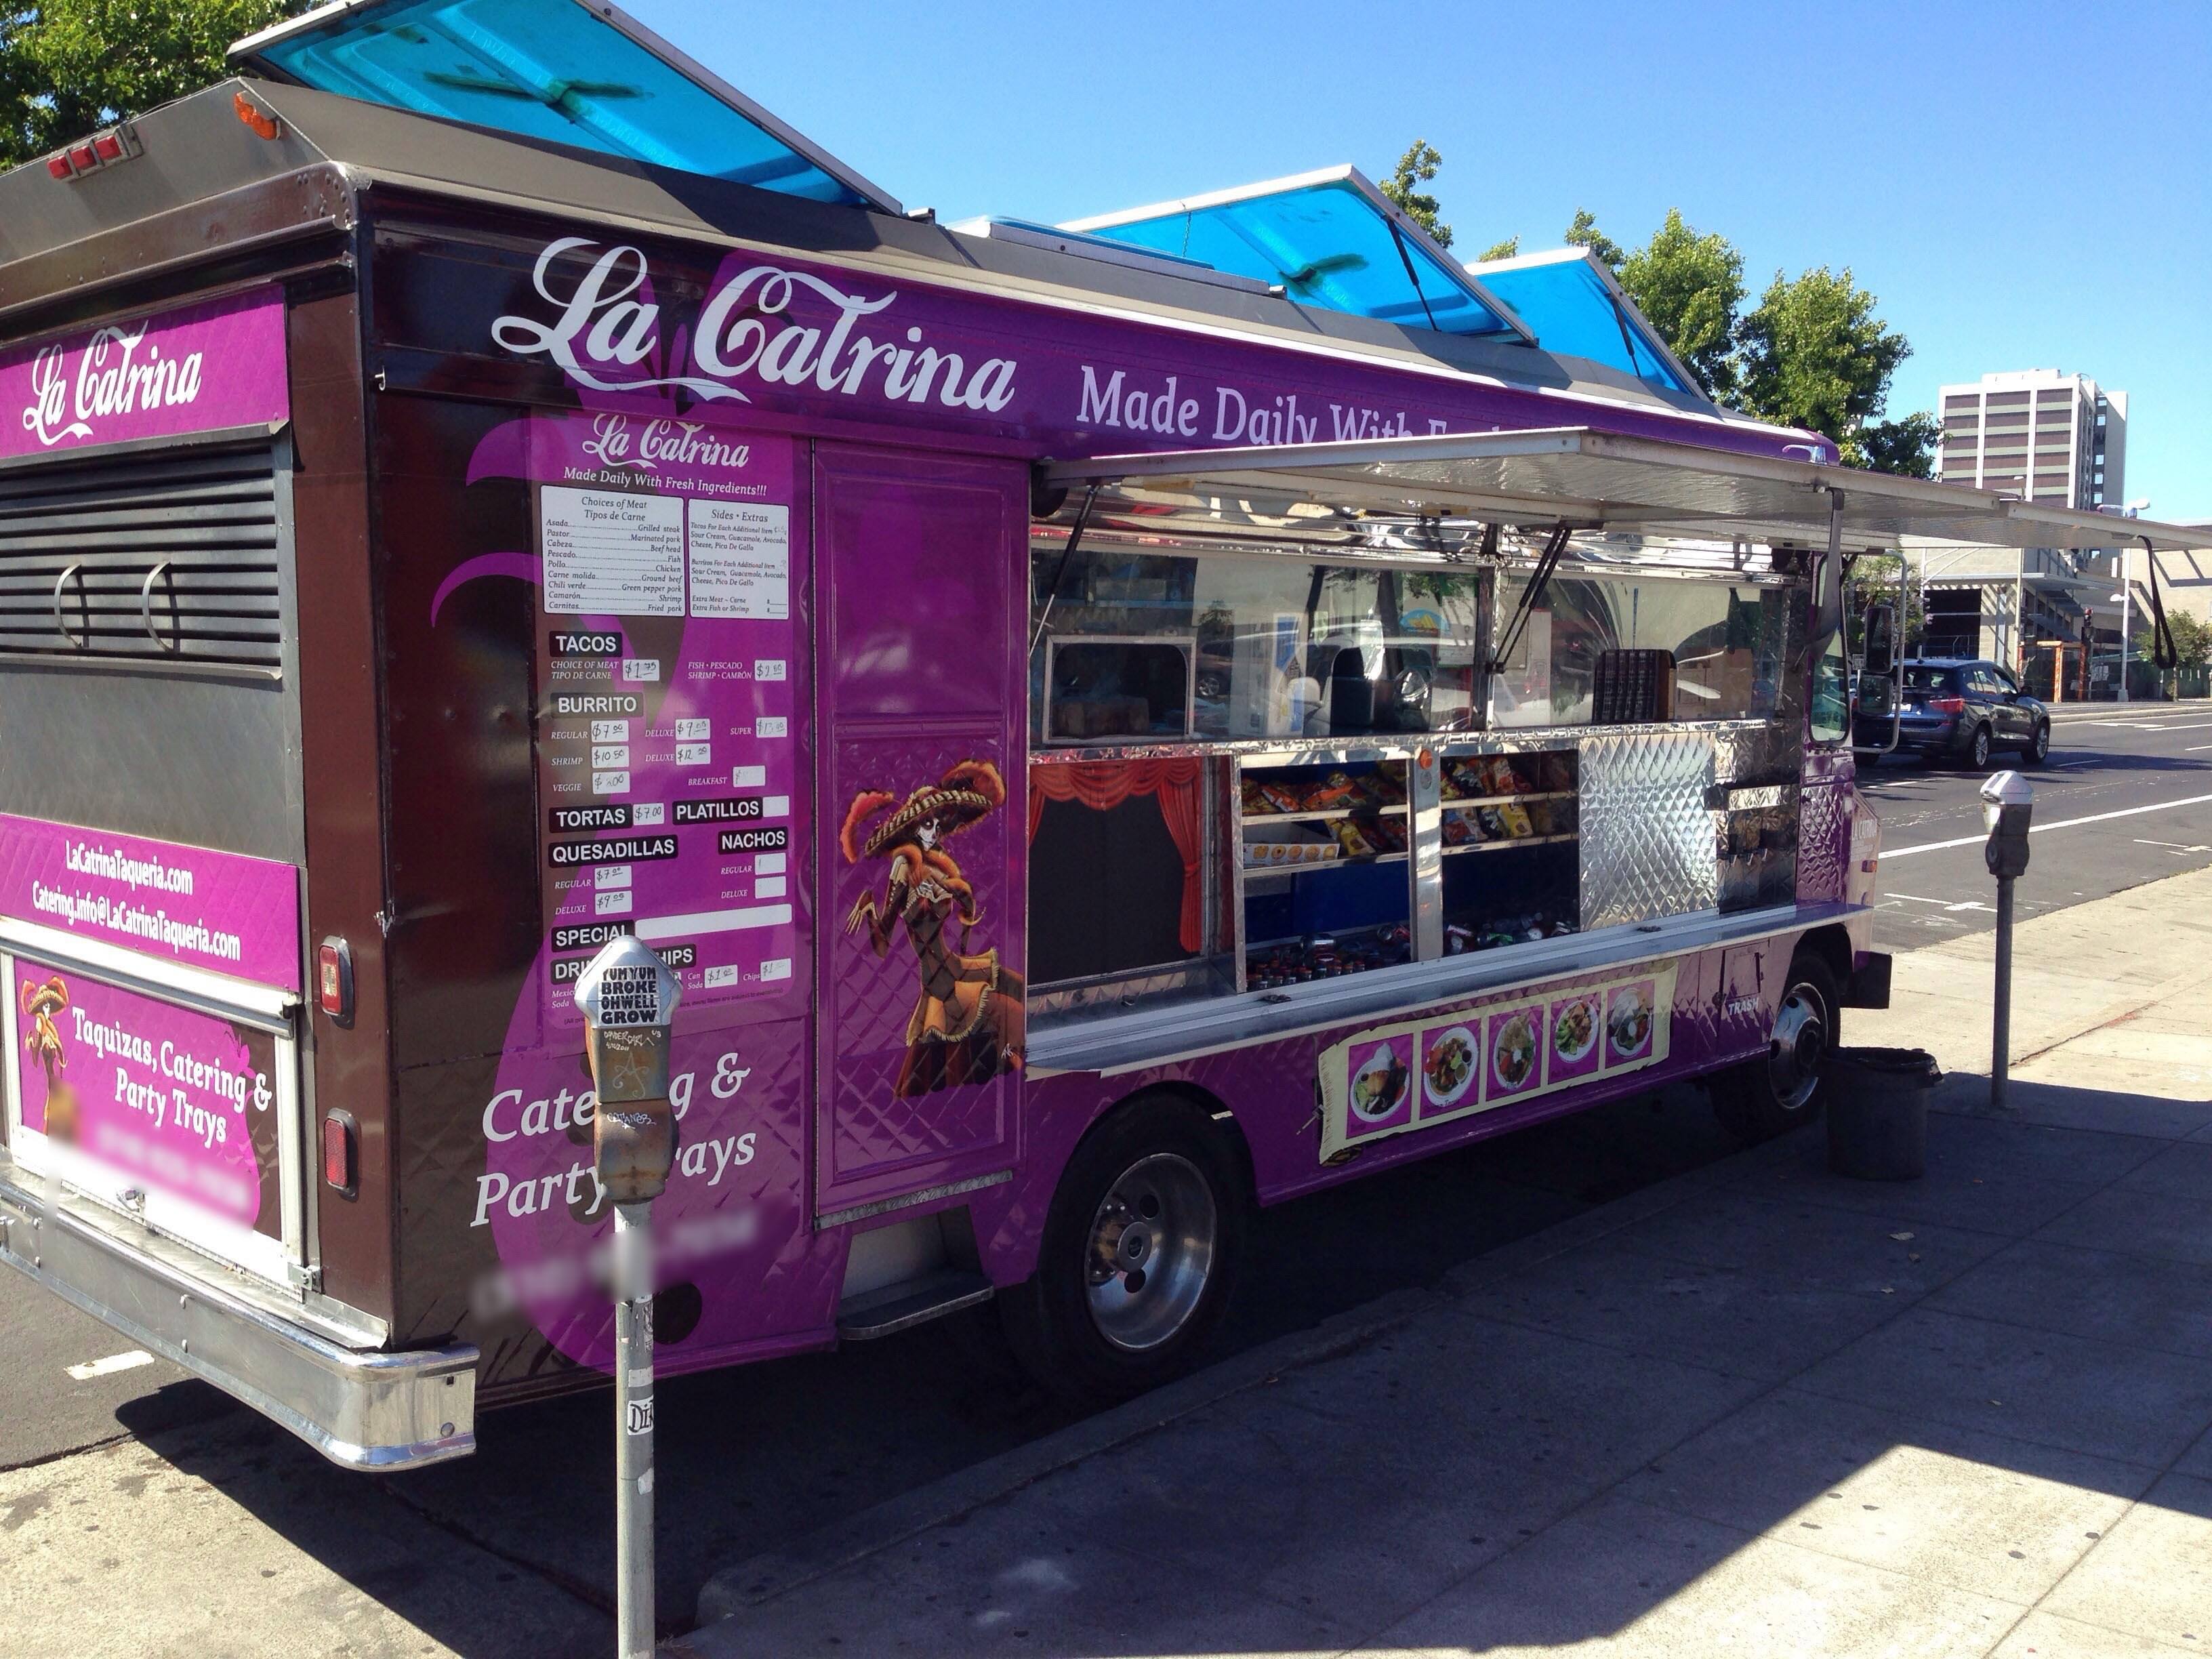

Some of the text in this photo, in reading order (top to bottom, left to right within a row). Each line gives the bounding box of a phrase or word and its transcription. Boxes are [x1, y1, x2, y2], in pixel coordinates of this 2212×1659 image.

[491, 237, 1017, 412] La Catrina
[22, 319, 203, 445] La Catrina
[1076, 365, 1200, 437] Made
[582, 413, 750, 468] La Catrina
[564, 467, 767, 497] Made Daily With Fresh Ingredients!!!
[581, 496, 648, 510] Choices of Meat
[585, 509, 646, 522] Tipos de Carne
[711, 510, 769, 523] Sides Extras
[546, 518, 568, 527] Asada
[638, 524, 660, 533] Grilled
[691, 521, 706, 529] Tacos
[733, 526, 760, 534] Additional
[547, 529, 680, 544] Pastor Marinated pork
[705, 532, 727, 541] Cream,
[547, 539, 681, 554] Cabeza Beef head
[715, 541, 728, 550] Pico
[548, 550, 576, 558] Pescado
[548, 560, 681, 573] Pollo Chicken
[691, 558, 713, 566] Burritos
[548, 570, 682, 584] Carne molida Ground beef
[548, 580, 565, 588] Chili
[642, 586, 665, 594] pepper
[667, 585, 682, 594] pork
[549, 590, 682, 603] Camarón Shrimp
[549, 601, 682, 613] Carnitas Fried pork
[729, 605, 750, 613] Shrimp
[555, 635, 617, 652] TACOS
[550, 661, 619, 669] CHOICE OF MEAT
[688, 661, 743, 670] FISH PESCADO
[551, 672, 613, 680] TIPO DE CARNE
[558, 697, 636, 713] BURRITO
[550, 731, 588, 739] REGULAR
[645, 729, 675, 737] DELUXE
[730, 727, 752, 735] SUPER
[551, 757, 583, 766] SHRIMP
[645, 754, 675, 762] DELUXE
[552, 783, 582, 792] VEGGIE
[688, 777, 729, 785] BREAKFAST
[676, 800, 760, 821] PLATILLOS
[556, 808, 626, 827] TORTAS
[722, 831, 786, 851] NACHOS
[552, 839, 675, 863] QUESADILLAS
[65, 840, 194, 895] LaCatrinaTaqueria.com
[720, 865, 752, 875] REGULAR
[554, 879, 592, 890] REGULAR
[720, 889, 748, 899] DELUXE
[555, 905, 587, 916] DELUXE
[32, 880, 241, 961] Catering.info@LaCatrinaTaqueria.com
[688, 972, 701, 981] Can
[743, 973, 760, 982] Chips
[601, 980, 657, 995] BROKE
[688, 981, 703, 990] Soda
[552, 1000, 569, 1009] Soda
[1728, 997, 1759, 1016] TRASH
[72, 1006, 272, 1115] Taquizas, Catering &
[482, 1052, 751, 1143] Categ &
[115, 1067, 227, 1149] Party Trays
[469, 1132, 757, 1227] Party ays
